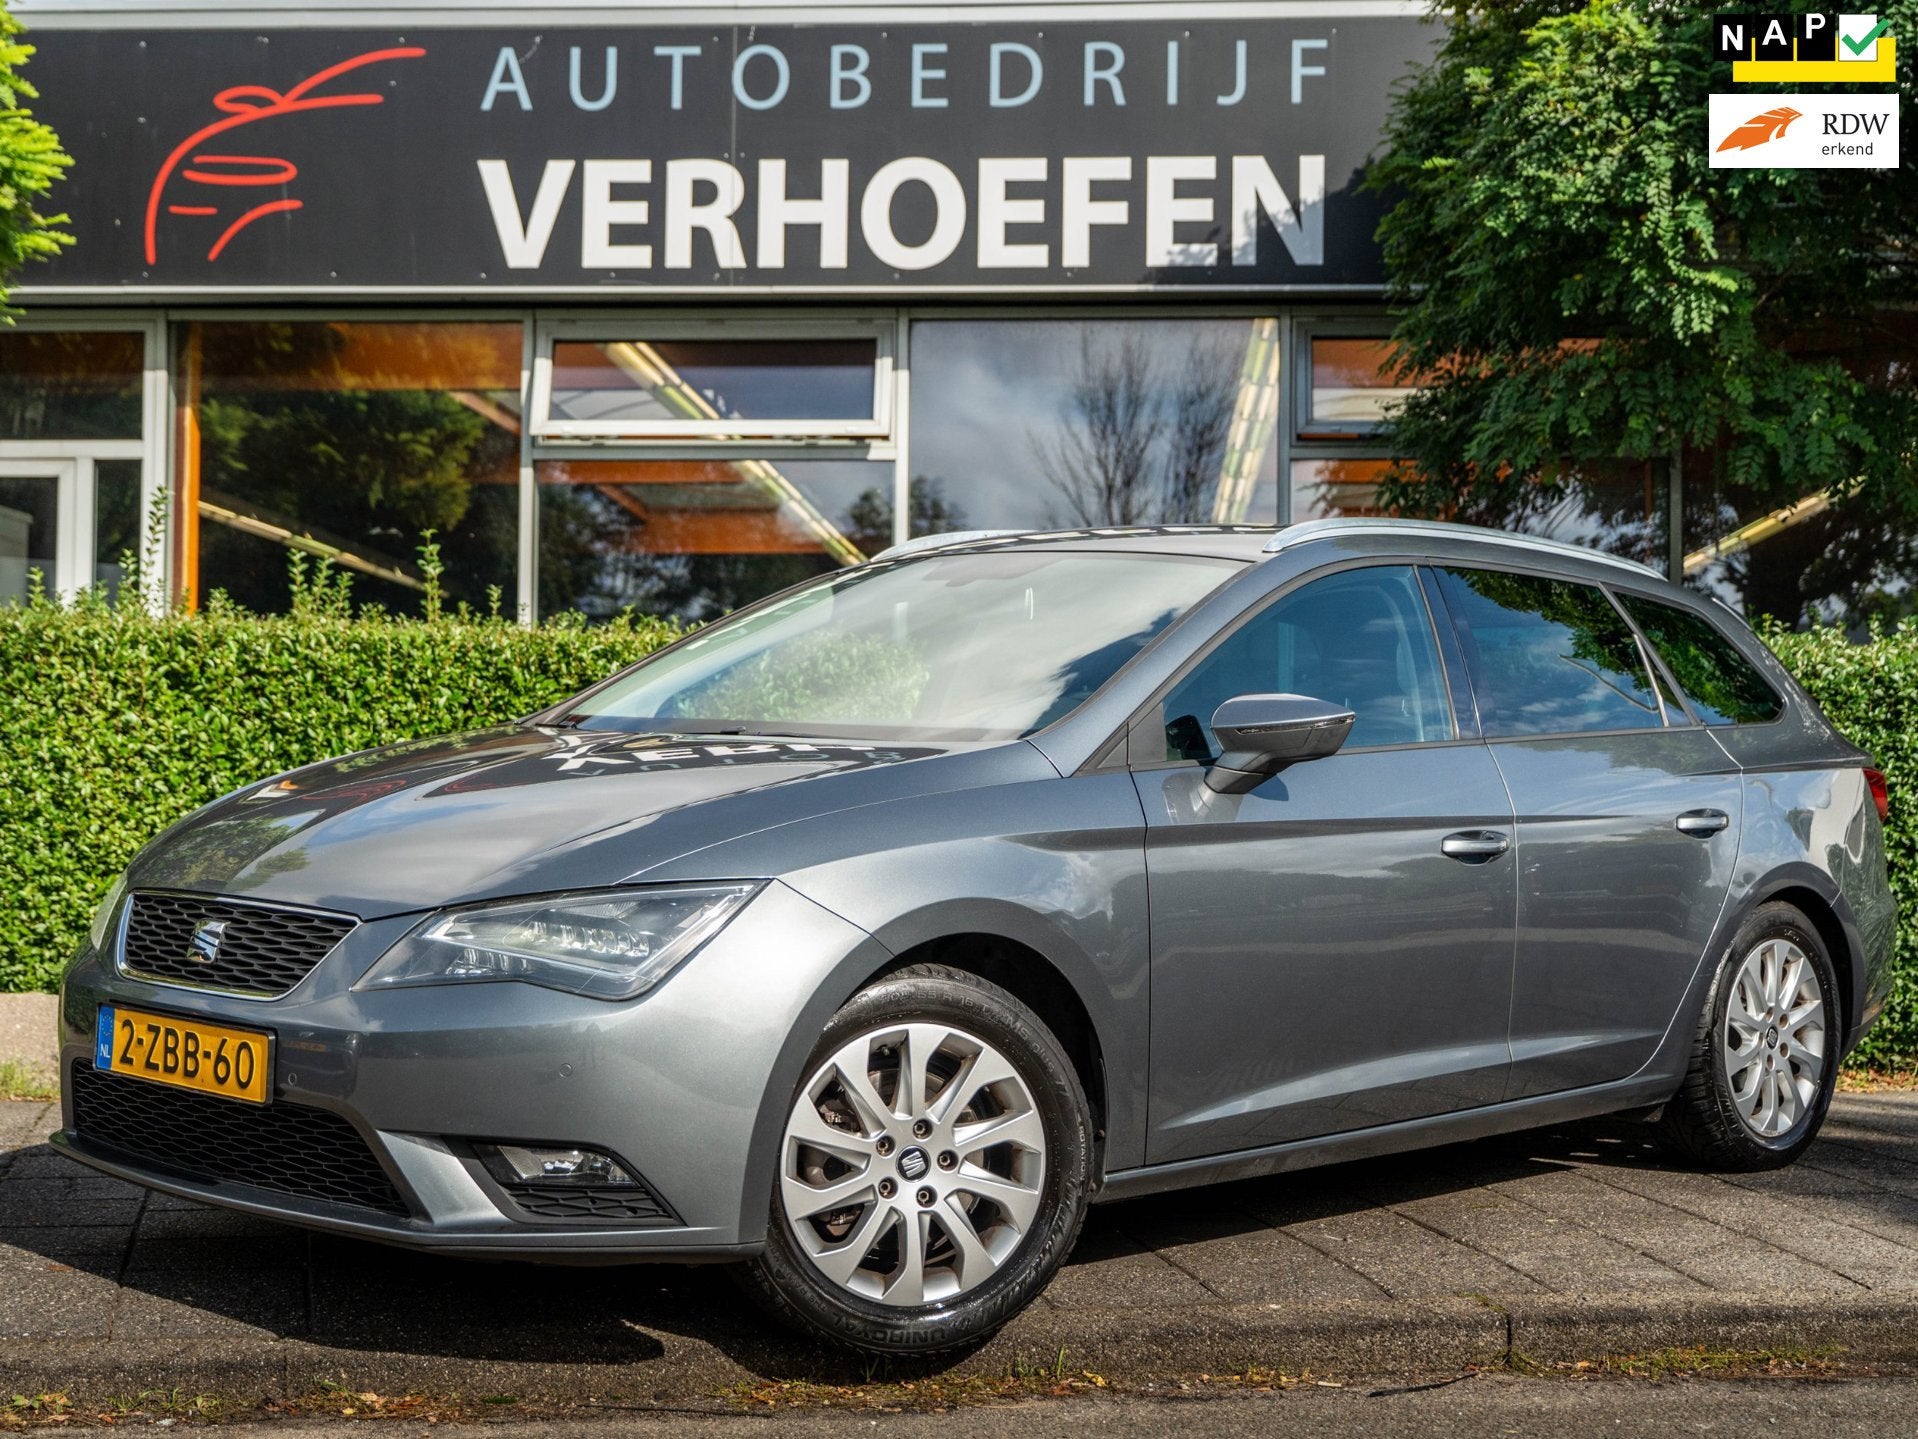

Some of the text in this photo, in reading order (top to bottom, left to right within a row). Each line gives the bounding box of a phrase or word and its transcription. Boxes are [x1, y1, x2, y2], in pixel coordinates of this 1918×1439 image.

[480, 38, 1329, 111] AUTOBEDRIJF
[476, 153, 1326, 271] VERHOEFEN
[99, 1043, 111, 1059] NL
[119, 1018, 255, 1090] 2-ZBB-60
[832, 1313, 948, 1345] UNIROYAL
